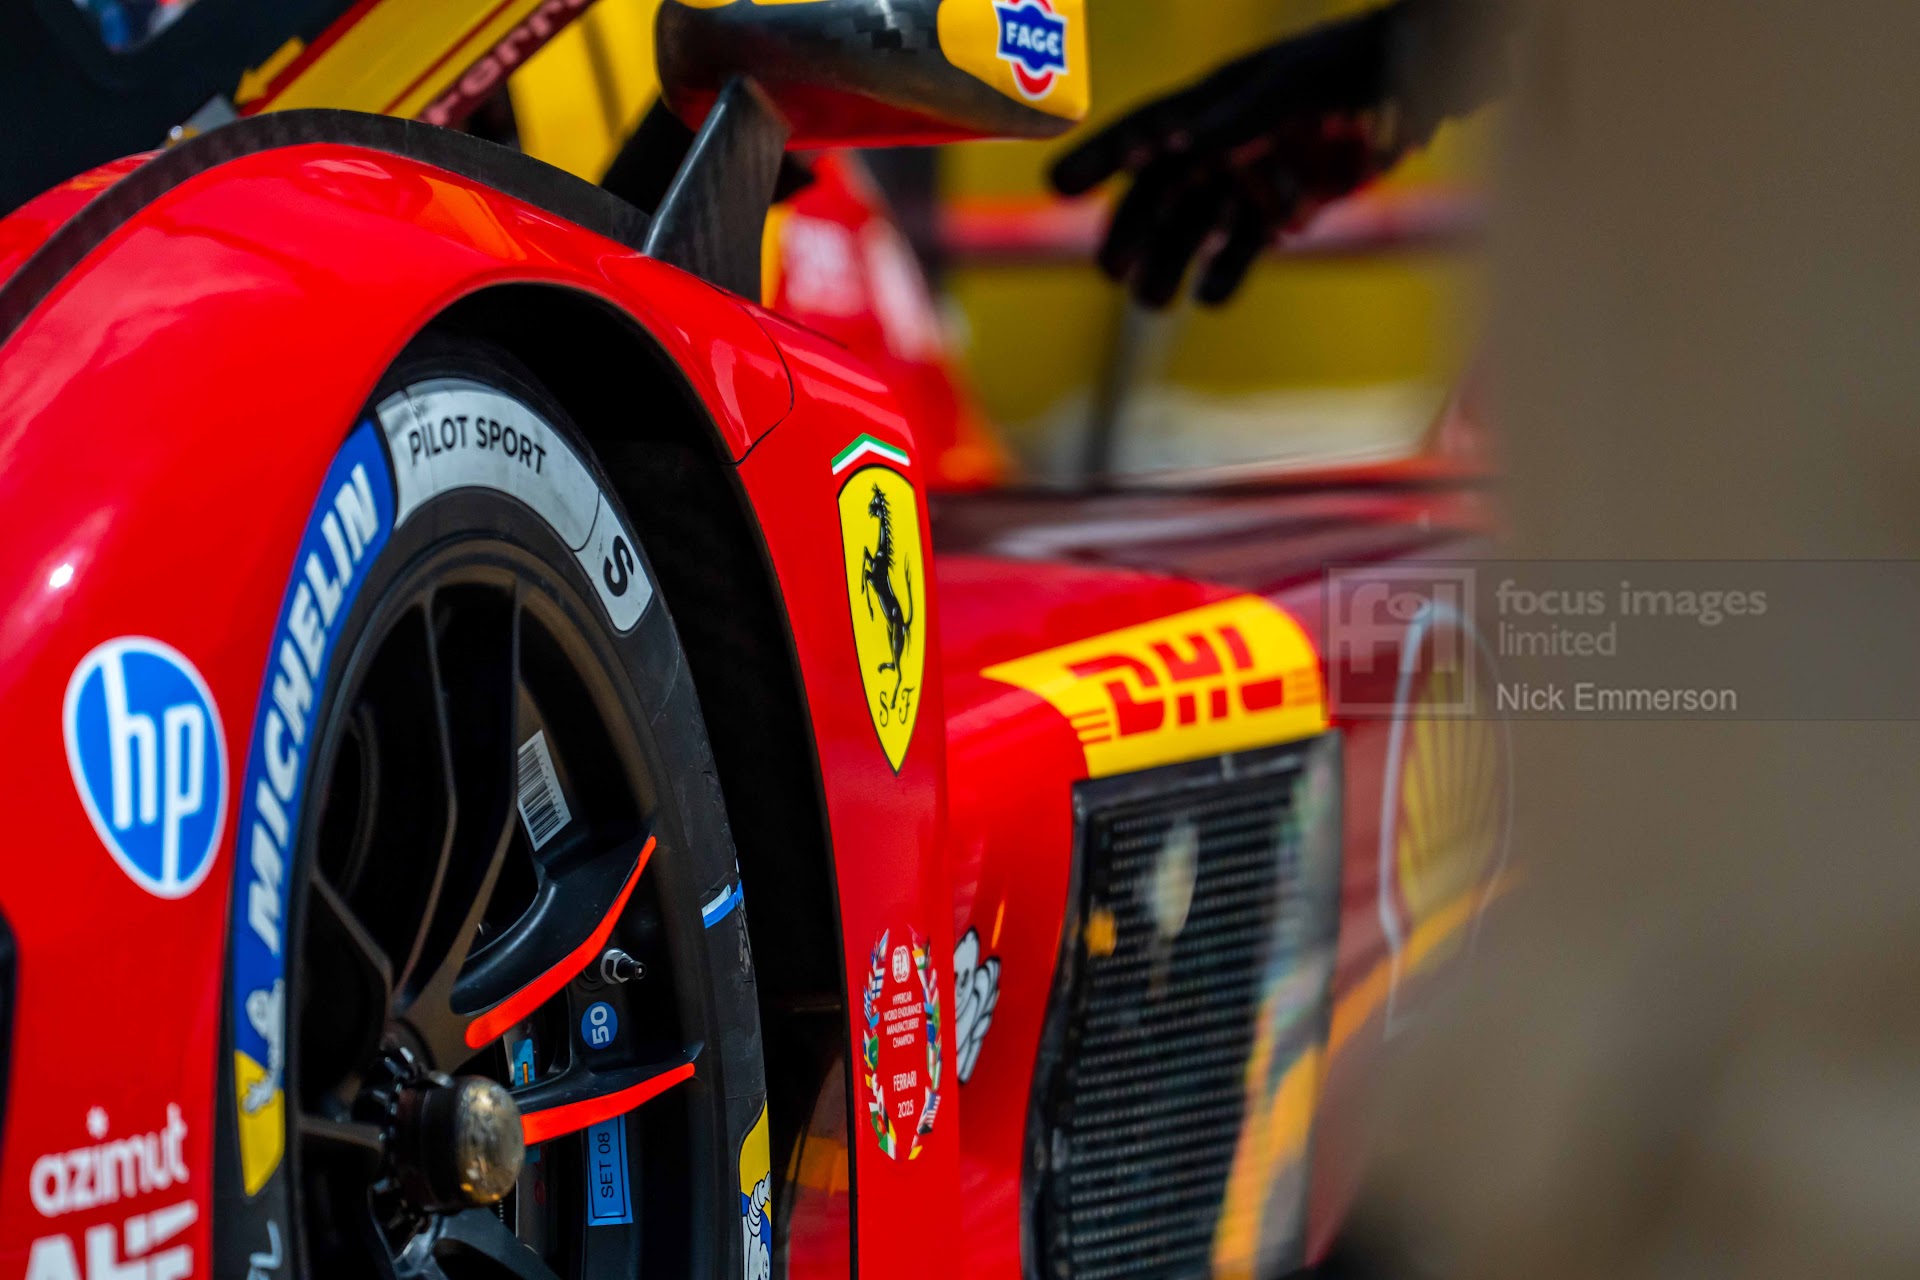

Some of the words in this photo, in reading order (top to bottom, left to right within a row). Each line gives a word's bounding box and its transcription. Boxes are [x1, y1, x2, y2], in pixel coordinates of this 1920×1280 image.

[409, 415, 469, 467] PILOT
[475, 417, 547, 475] SPORT
[603, 535, 634, 597] S
[248, 462, 380, 955] MICHELIN
[1065, 624, 1284, 738] DHL
[99, 645, 206, 892] hp
[590, 1005, 610, 1045] 50
[893, 1070, 917, 1092] FERRARI
[897, 1099, 914, 1119] 2025
[29, 1101, 190, 1218] azimut
[597, 1131, 611, 1155] 08
[599, 1160, 614, 1199] SET
